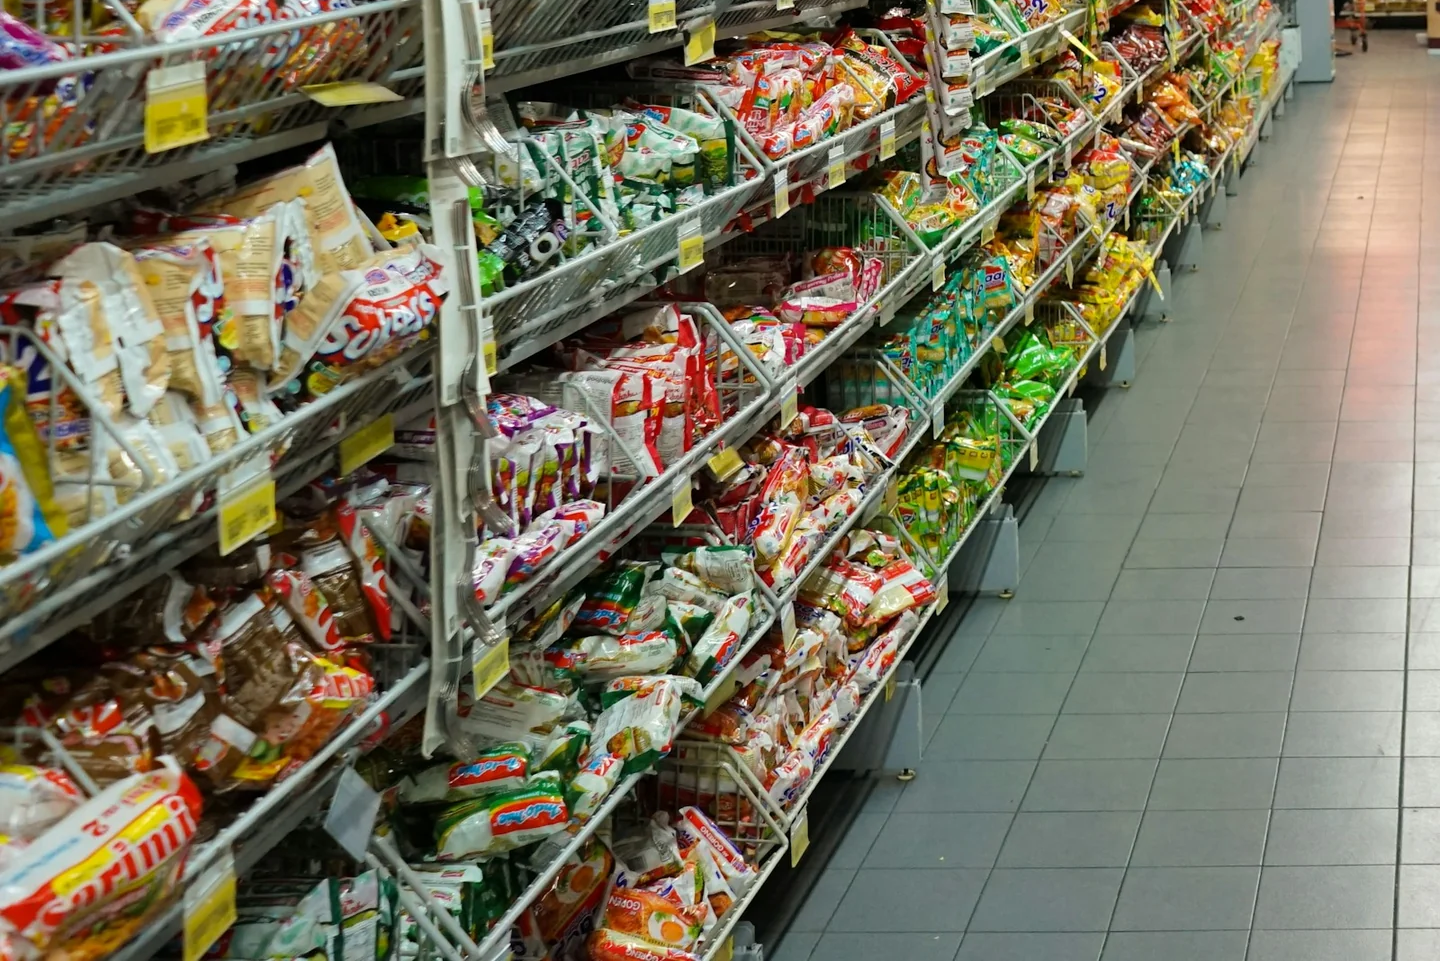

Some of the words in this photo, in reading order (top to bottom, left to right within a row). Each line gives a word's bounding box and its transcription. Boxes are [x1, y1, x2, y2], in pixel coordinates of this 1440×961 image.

[497, 803, 564, 825] Indomie
[700, 825, 726, 854] GORENG
[607, 893, 642, 911] GOREN
